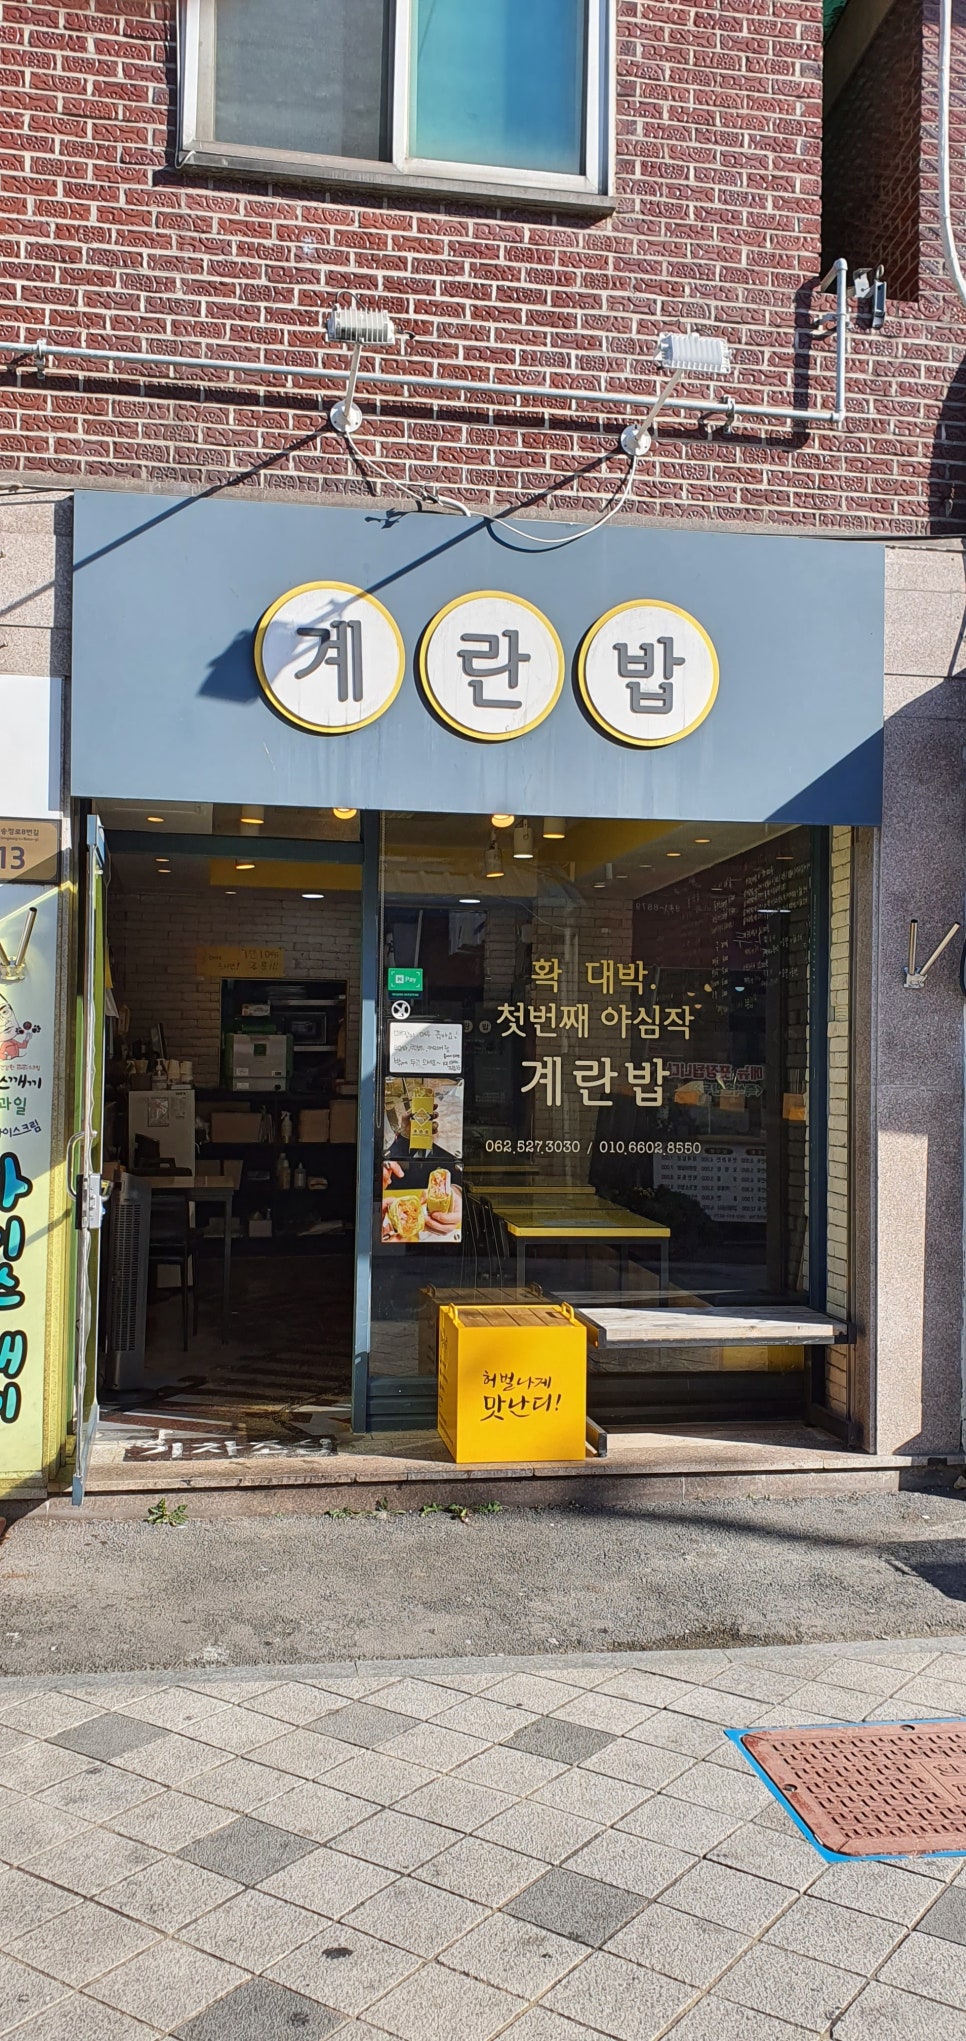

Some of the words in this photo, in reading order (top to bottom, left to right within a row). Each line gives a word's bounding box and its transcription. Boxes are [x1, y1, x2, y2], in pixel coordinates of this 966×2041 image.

[405, 975, 417, 984] Pay
[530, 958, 562, 995] 확
[585, 958, 657, 996] 대박.
[496, 1002, 589, 1040] 첫번째
[600, 1004, 696, 1040] 야심작
[521, 1056, 672, 1108] 계란밥
[0, 1118, 42, 1138] 이스크림
[485, 1139, 581, 1156] 062.527.3030
[599, 1140, 703, 1157] 010.6602.8550
[482, 1370, 552, 1391] 허벌나게
[480, 1393, 562, 1422] 맛난디!
